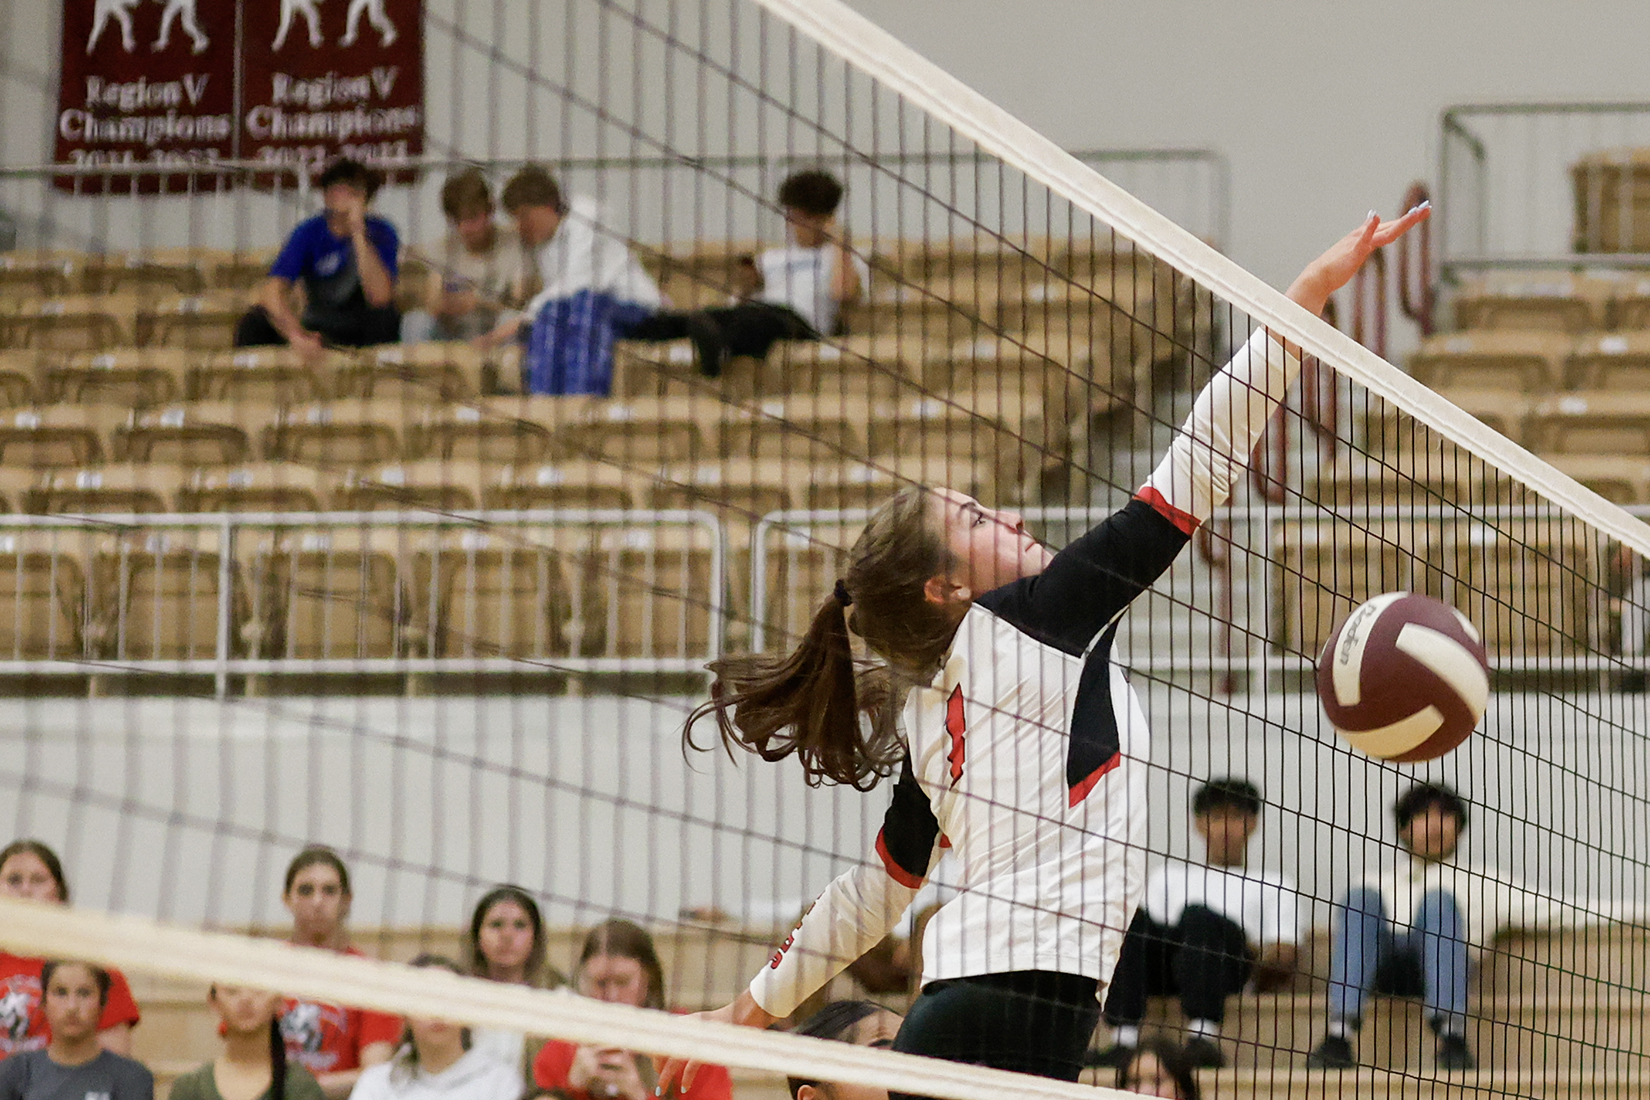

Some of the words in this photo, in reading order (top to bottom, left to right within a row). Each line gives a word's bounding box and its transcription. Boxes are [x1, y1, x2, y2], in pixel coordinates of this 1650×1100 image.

[86, 75, 181, 111] Region
[183, 73, 211, 106] V
[271, 71, 370, 110] Region
[371, 65, 399, 100] V
[59, 108, 231, 146] Champions
[245, 104, 416, 144] Champions
